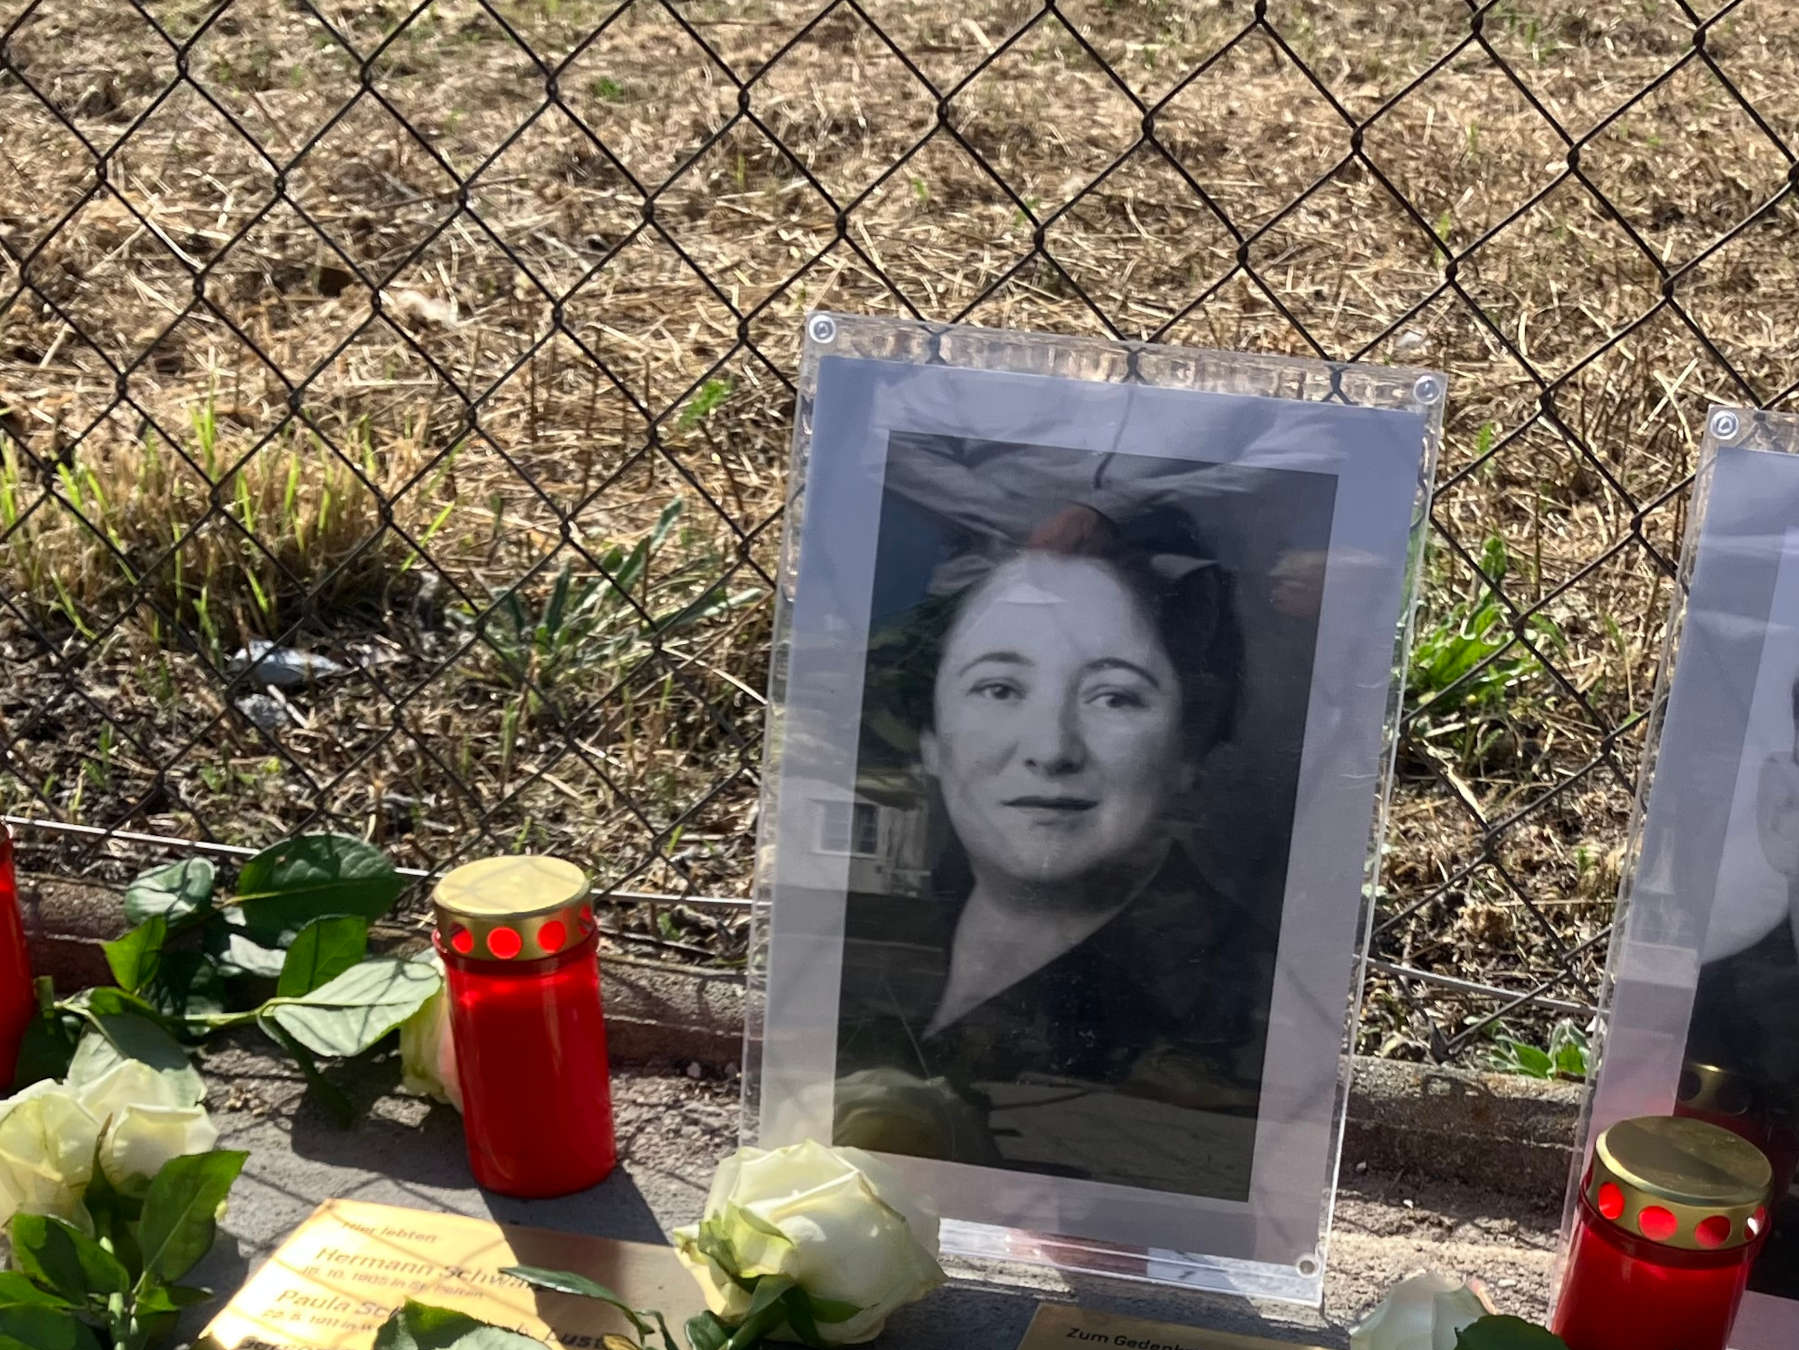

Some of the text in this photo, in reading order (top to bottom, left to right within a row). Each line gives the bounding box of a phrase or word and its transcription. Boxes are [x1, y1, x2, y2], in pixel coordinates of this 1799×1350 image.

[315, 1248, 434, 1277] Hermann
[276, 1289, 351, 1313] Paula
[1066, 1327, 1109, 1344] Zum
